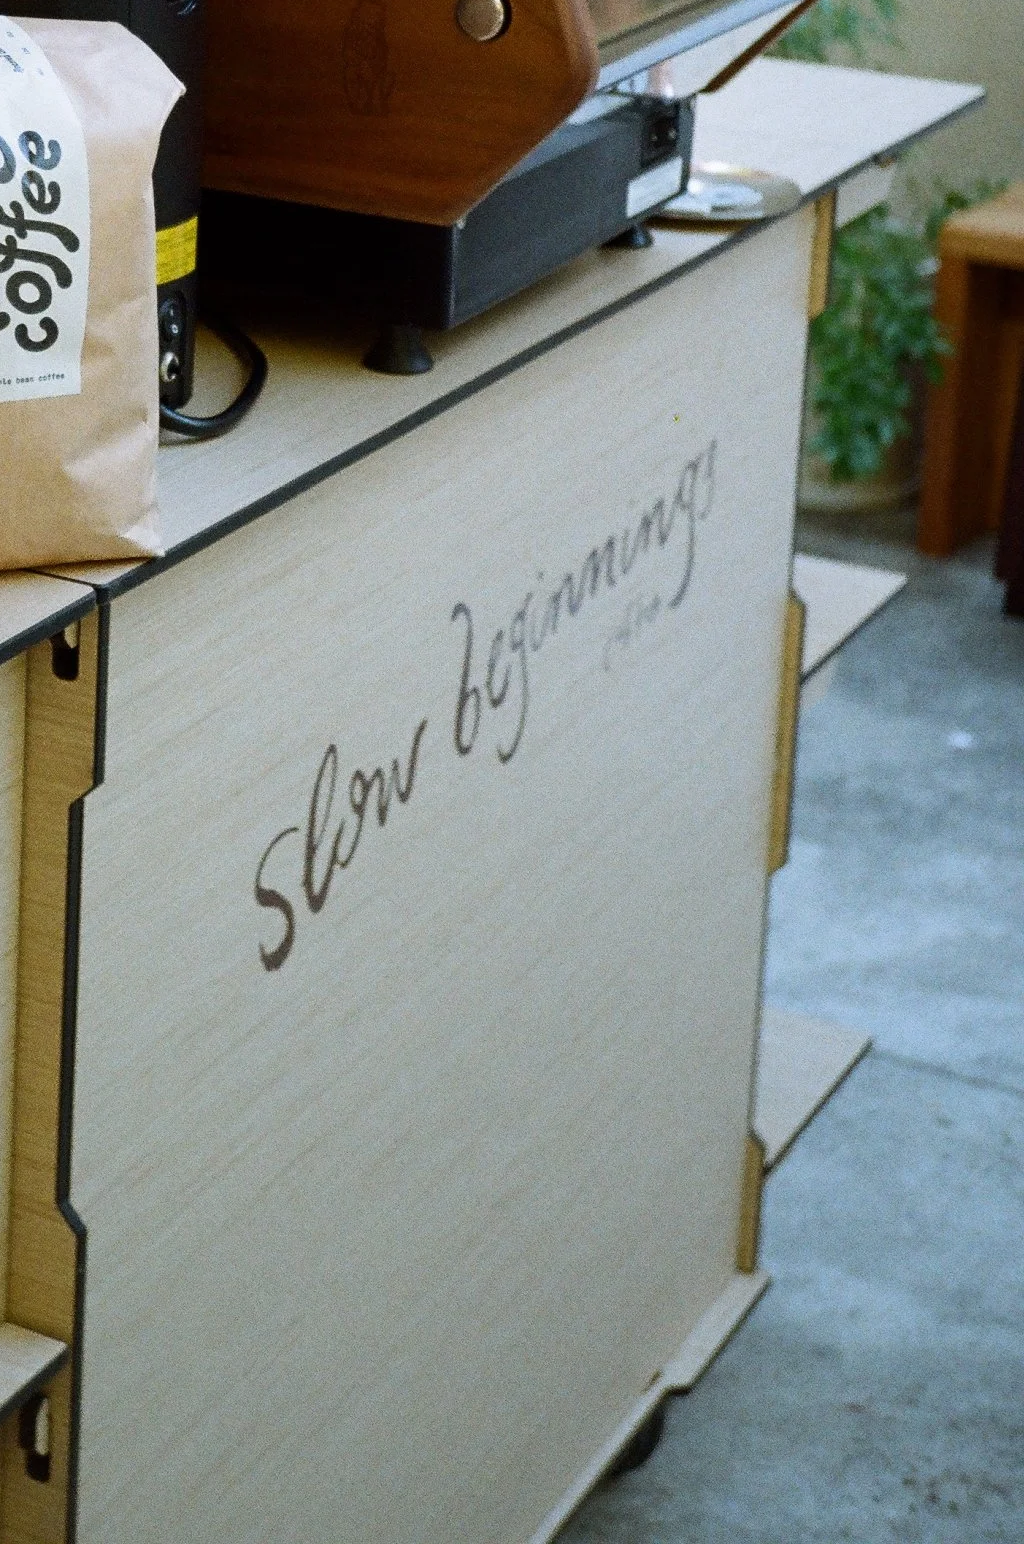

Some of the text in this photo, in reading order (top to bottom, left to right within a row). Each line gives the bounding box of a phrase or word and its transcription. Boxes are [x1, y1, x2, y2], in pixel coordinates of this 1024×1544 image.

[16, 376, 34, 385] bean
[38, 373, 65, 383] coffee
[451, 438, 718, 765] beginnings
